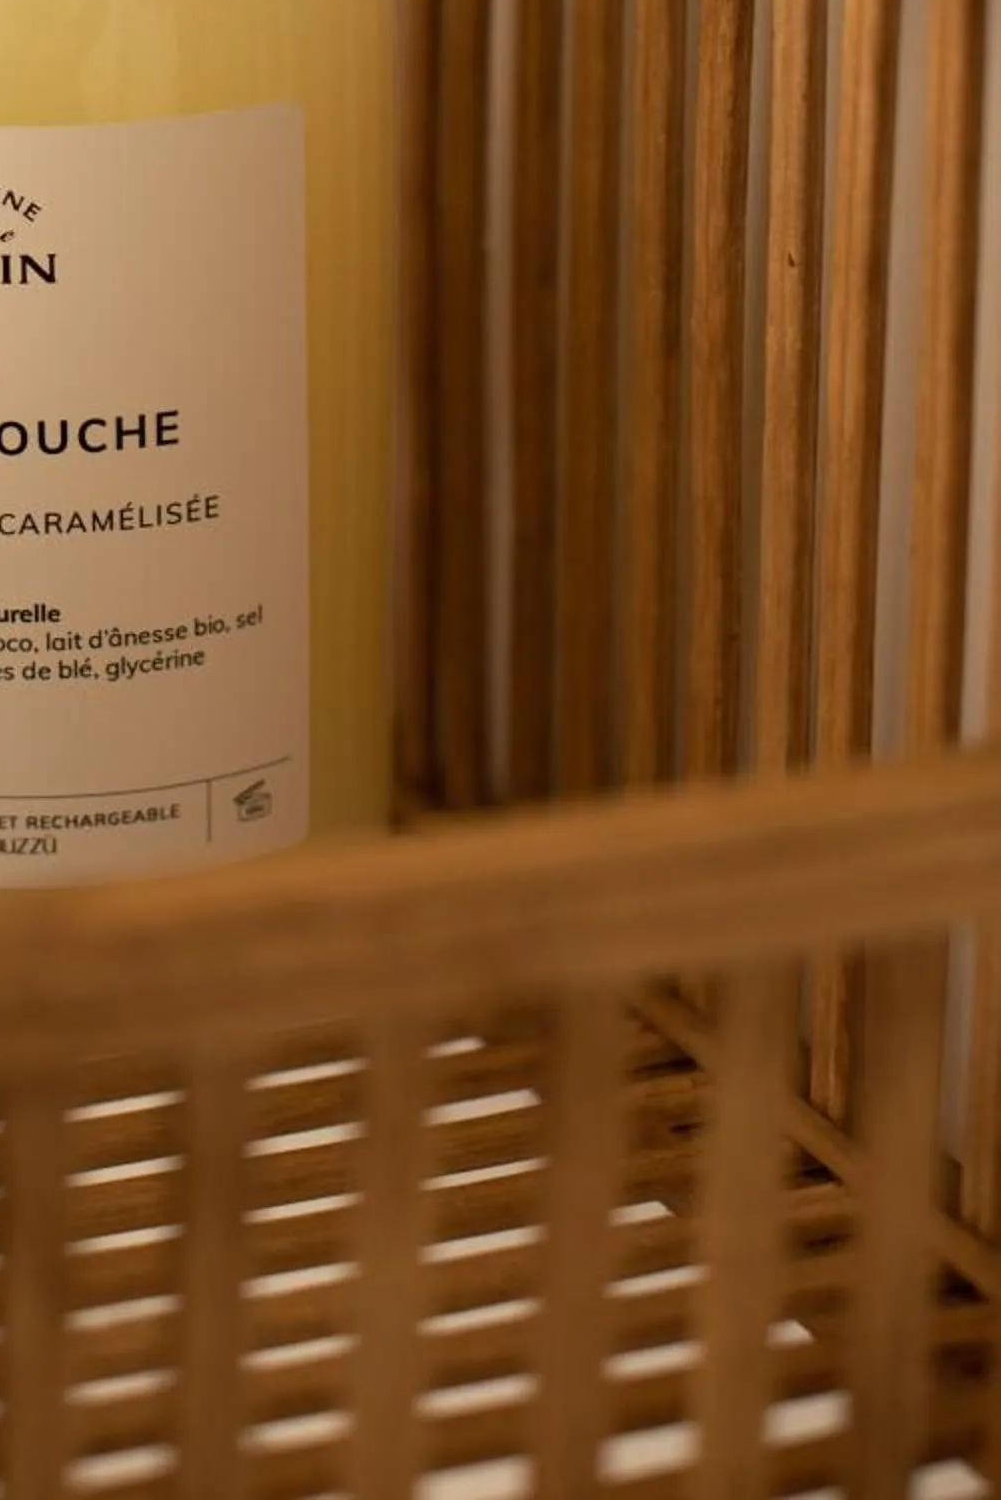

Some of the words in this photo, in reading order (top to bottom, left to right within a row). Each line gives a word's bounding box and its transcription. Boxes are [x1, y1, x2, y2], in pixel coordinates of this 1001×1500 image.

[46, 632, 83, 652] lait
[88, 627, 189, 650] d'ânesse
[194, 617, 231, 638] bio,
[236, 604, 264, 628] sel
[21, 661, 52, 681] de
[58, 657, 100, 680] blé,
[105, 649, 206, 683] glycérine
[25, 803, 181, 831] RECHARGEABLE
